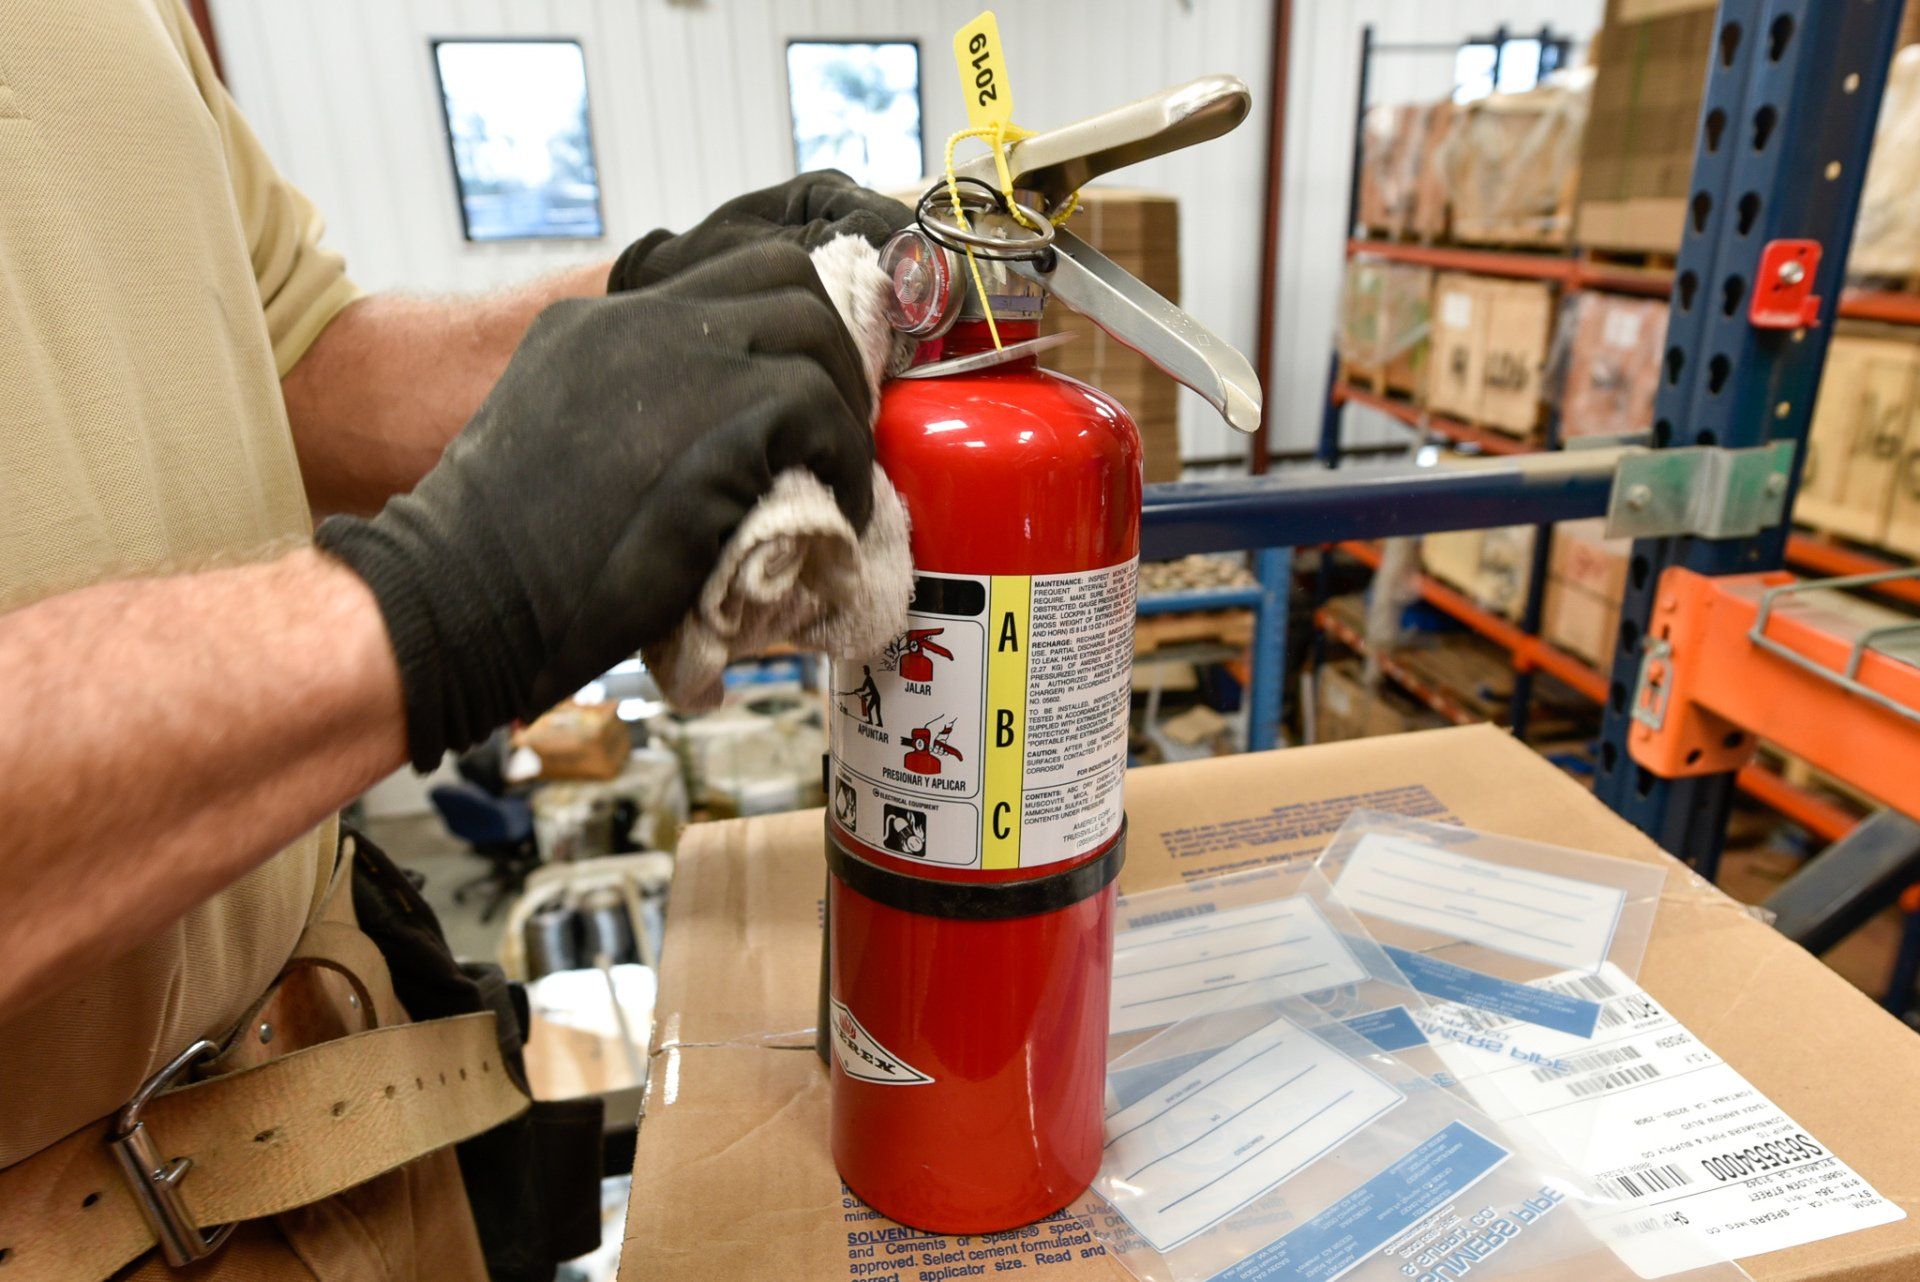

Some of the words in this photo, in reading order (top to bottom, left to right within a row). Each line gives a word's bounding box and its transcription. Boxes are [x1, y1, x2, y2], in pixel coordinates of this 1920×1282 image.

[969, 33, 997, 106] 2019
[1034, 578, 1083, 588] MAINTENANCE:
[1088, 573, 1110, 582] INSPECT
[1034, 588, 1070, 596] FREQUENT
[1079, 581, 1108, 592] INTERVALS
[1090, 590, 1104, 598] SURE
[1060, 610, 1086, 619] LOCKPIN
[1094, 604, 1112, 613] TAMPER
[1079, 600, 1097, 608] GAUGE
[1032, 622, 1056, 630] GROSS
[1060, 618, 1084, 627] WEIGHT
[998, 612, 1018, 652] A
[1048, 628, 1068, 637] HORN)
[1032, 639, 1072, 648] RECHARGE:
[1076, 632, 1106, 643] RECHARGE
[1050, 646, 1074, 655] PARTIAL
[1078, 640, 1106, 652] DISCHARGE
[1080, 644, 1114, 658] EXTINGUISHER
[1080, 656, 1102, 666] AMEREX
[1030, 670, 1076, 681] PRESSURIZED
[1077, 667, 1091, 675] WITH
[1048, 675, 1088, 687] AUTHORIZED
[904, 682, 932, 696] JALAR
[1030, 688, 1065, 697] CHARGER)
[1077, 676, 1110, 690] ACCORDANCE
[1030, 716, 1054, 724] TESTED
[1065, 704, 1100, 719] ACCORDANCE
[858, 723, 888, 744] APUNTAR
[996, 709, 1014, 748] B
[1028, 722, 1060, 731] SUPPLIED
[1028, 729, 1070, 738] PROTECTION
[1064, 744, 1082, 752] AFTER
[1087, 738, 1097, 746] USE
[1026, 756, 1060, 766] SURFACES
[1064, 747, 1095, 761] CONTACTED
[1026, 764, 1064, 774] CORROSION
[882, 766, 922, 787] PRESIONAR
[924, 777, 930, 787] Y
[932, 779, 966, 791] APLICAR
[1083, 780, 1093, 790] DRY
[880, 792, 908, 806] ELECTRICAL
[908, 800, 939, 811] EQUIPMENT
[1024, 806, 1062, 816] AMMONIUM
[1064, 797, 1089, 810] SULFATE
[1025, 797, 1064, 808] MUSCOVITE
[1024, 814, 1060, 825] CONTENTS
[1060, 808, 1080, 818] UNDER
[1081, 798, 1104, 812] PRESSURE
[993, 802, 1011, 840] C
[1073, 816, 1097, 830] AMEREX
[1732, 1116, 1785, 1138] CONSUMERS
[1704, 1130, 1730, 1144] PIPE
[1661, 1140, 1694, 1155] SUPPLY
[1701, 1134, 1823, 1182] S653554000
[1750, 1185, 1784, 1202] STREET
[1750, 1208, 1791, 1225] SPEARS
[848, 1227, 916, 1245] SOLVENT
[848, 1245, 874, 1258] and
[886, 1240, 946, 1254] Cements
[1049, 1217, 1095, 1236] special
[850, 1255, 918, 1276] approved.
[922, 1250, 966, 1266] Select
[968, 1244, 1018, 1258] cement
[1021, 1232, 1091, 1252] formulated
[1093, 1230, 1111, 1240] for
[1114, 1226, 1136, 1240] the
[918, 1264, 985, 1282] applicator
[994, 1256, 1026, 1272] size.
[1035, 1250, 1072, 1266] Read
[1080, 1244, 1106, 1259] and
